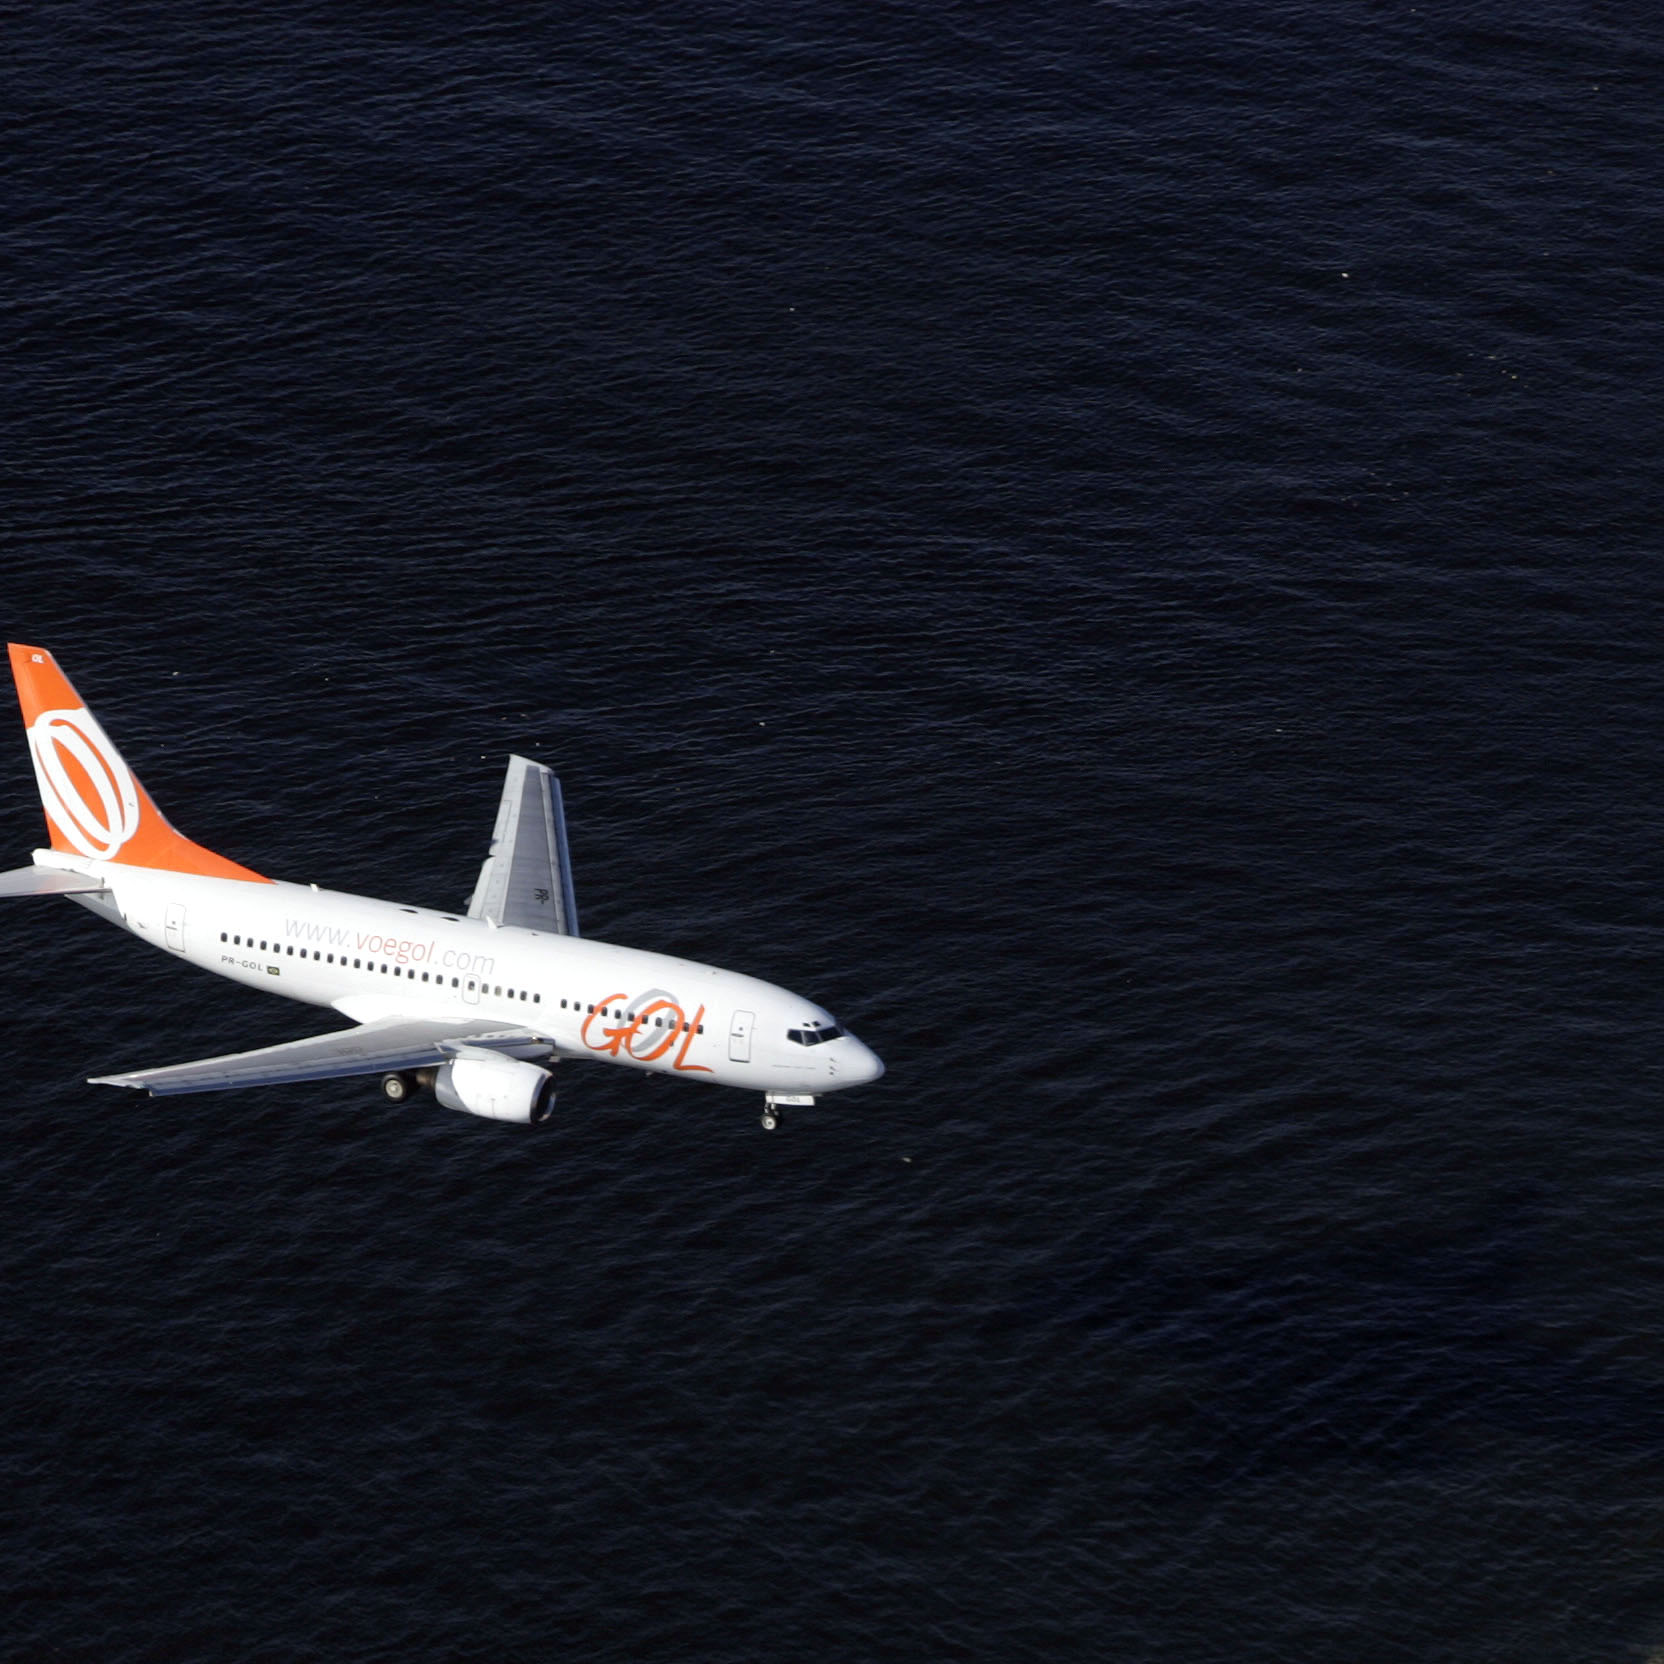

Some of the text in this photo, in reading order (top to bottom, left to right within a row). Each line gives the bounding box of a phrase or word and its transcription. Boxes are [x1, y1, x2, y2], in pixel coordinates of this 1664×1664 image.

[221, 955, 263, 972] PR-GOL
[285, 917, 495, 975] www.voegol.com
[581, 989, 714, 1073] GOL
